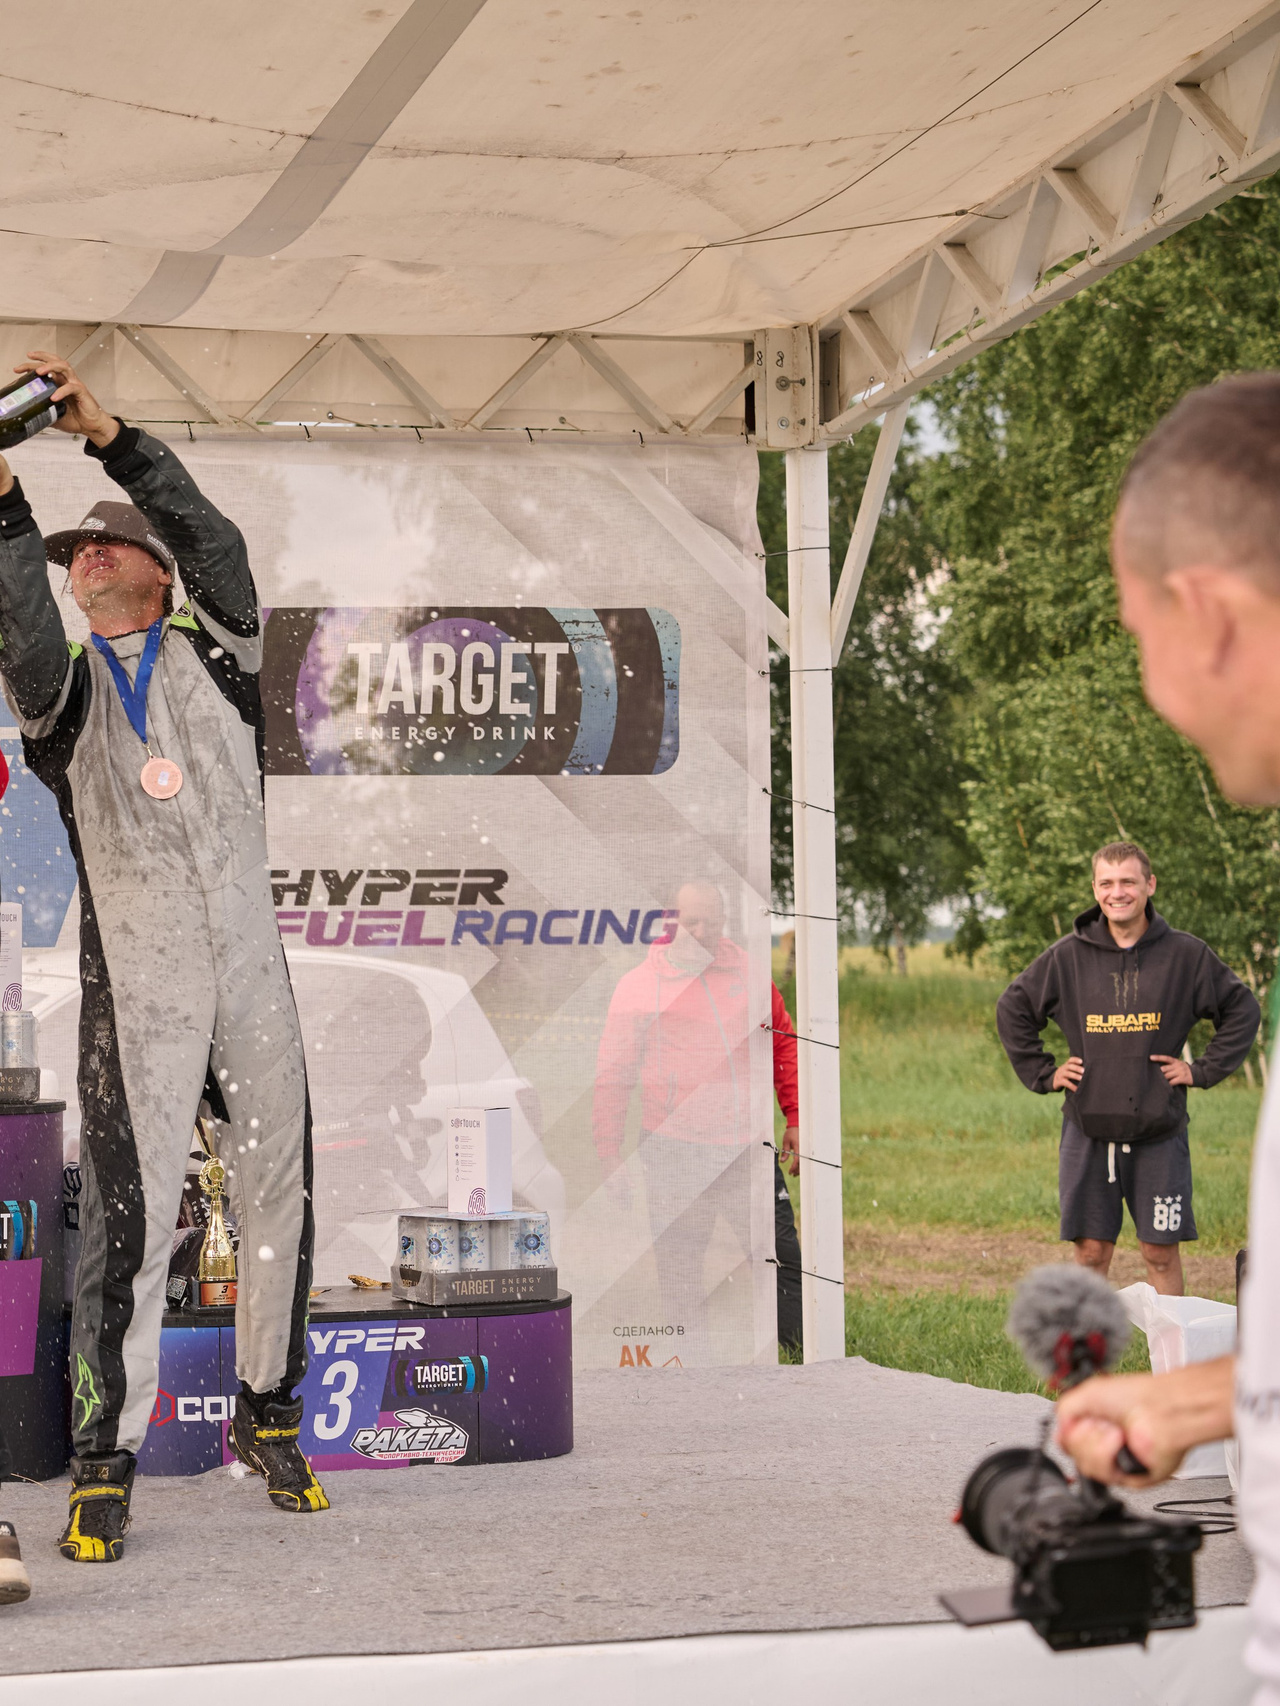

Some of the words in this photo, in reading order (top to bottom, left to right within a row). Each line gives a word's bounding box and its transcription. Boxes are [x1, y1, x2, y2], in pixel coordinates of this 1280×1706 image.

[347, 642, 569, 716] TARGET
[354, 726, 457, 741] ENERGY
[473, 725, 557, 741] DRINK
[270, 868, 509, 906] HYPER
[451, 909, 681, 946] RACING
[1086, 1012, 1161, 1027] SUBARU
[1152, 1202, 1183, 1233] 86
[455, 1279, 496, 1296] TARGET
[502, 1277, 542, 1285] ENERGY
[502, 1285, 535, 1294] DRINK
[613, 1326, 674, 1338] СДЕЛАНО
[677, 1325, 686, 1336] В
[415, 1364, 466, 1383] TARGET
[313, 1360, 359, 1440] 3
[351, 1427, 468, 1453] РАКЕТА
[383, 1449, 466, 1459] СПОРТИВНО-ТЕХНИЧЕСКИЙ
